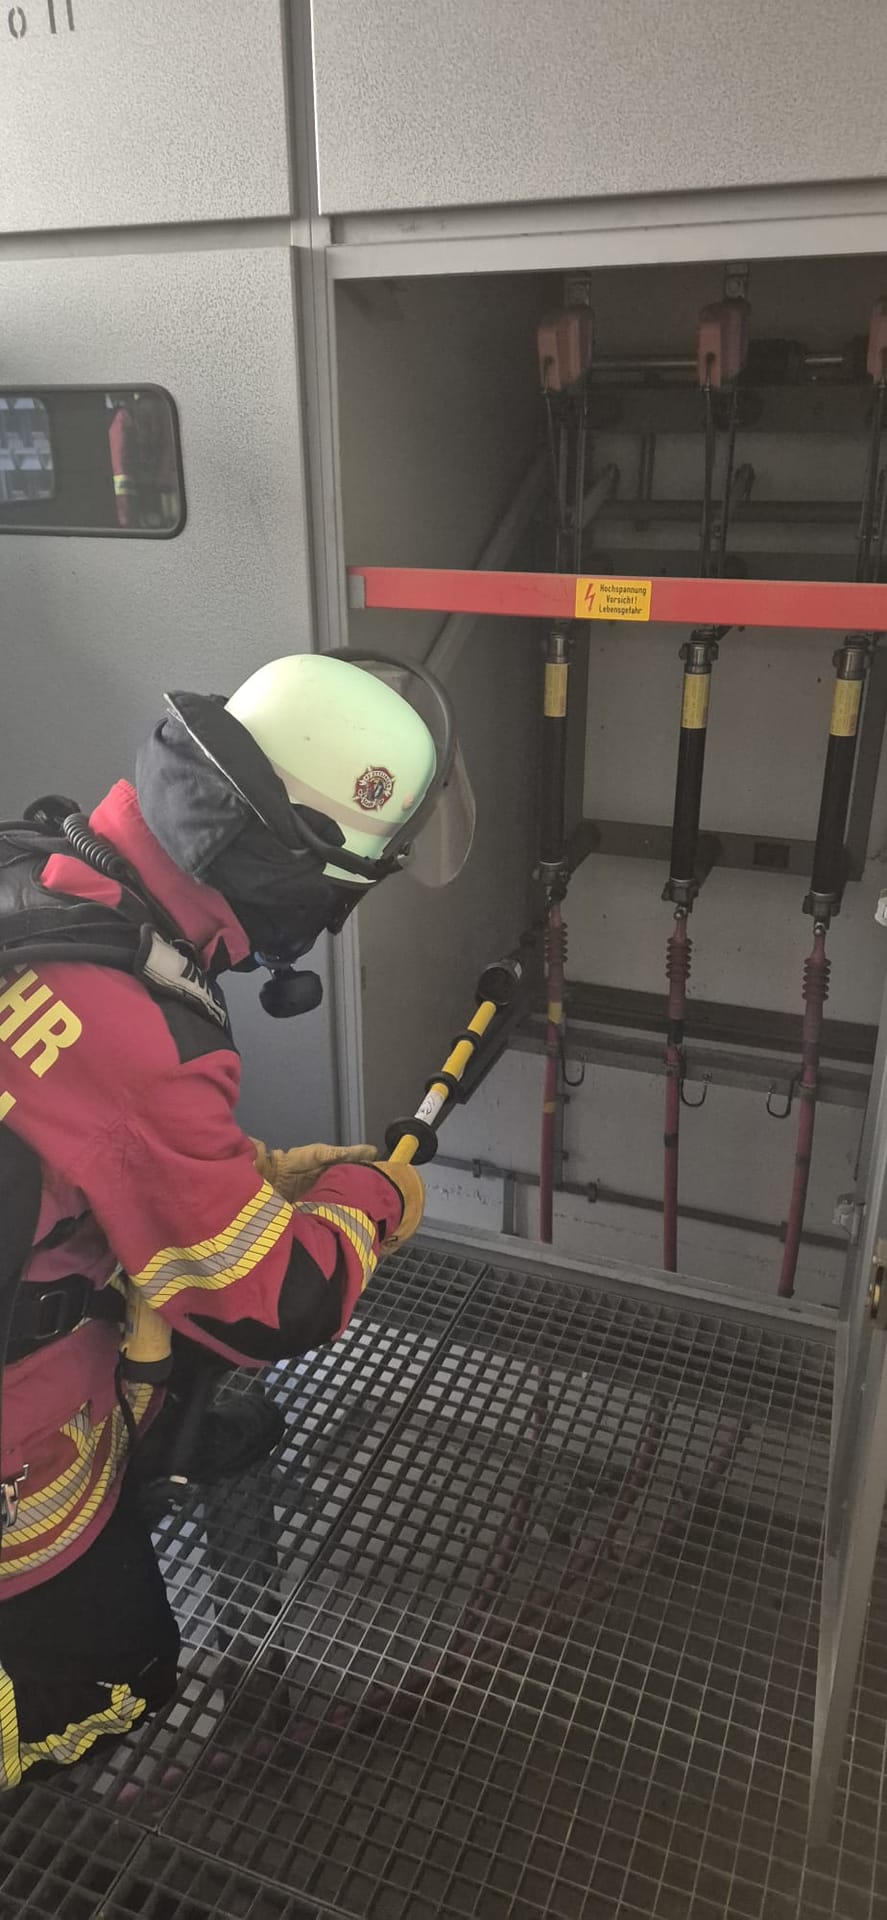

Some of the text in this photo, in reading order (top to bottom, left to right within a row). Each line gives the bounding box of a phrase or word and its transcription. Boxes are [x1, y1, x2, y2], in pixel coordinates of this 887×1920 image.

[600, 584, 646, 596] Hochspannung
[599, 604, 643, 615] Lebensgefahr
[0, 964, 82, 1078] HR
